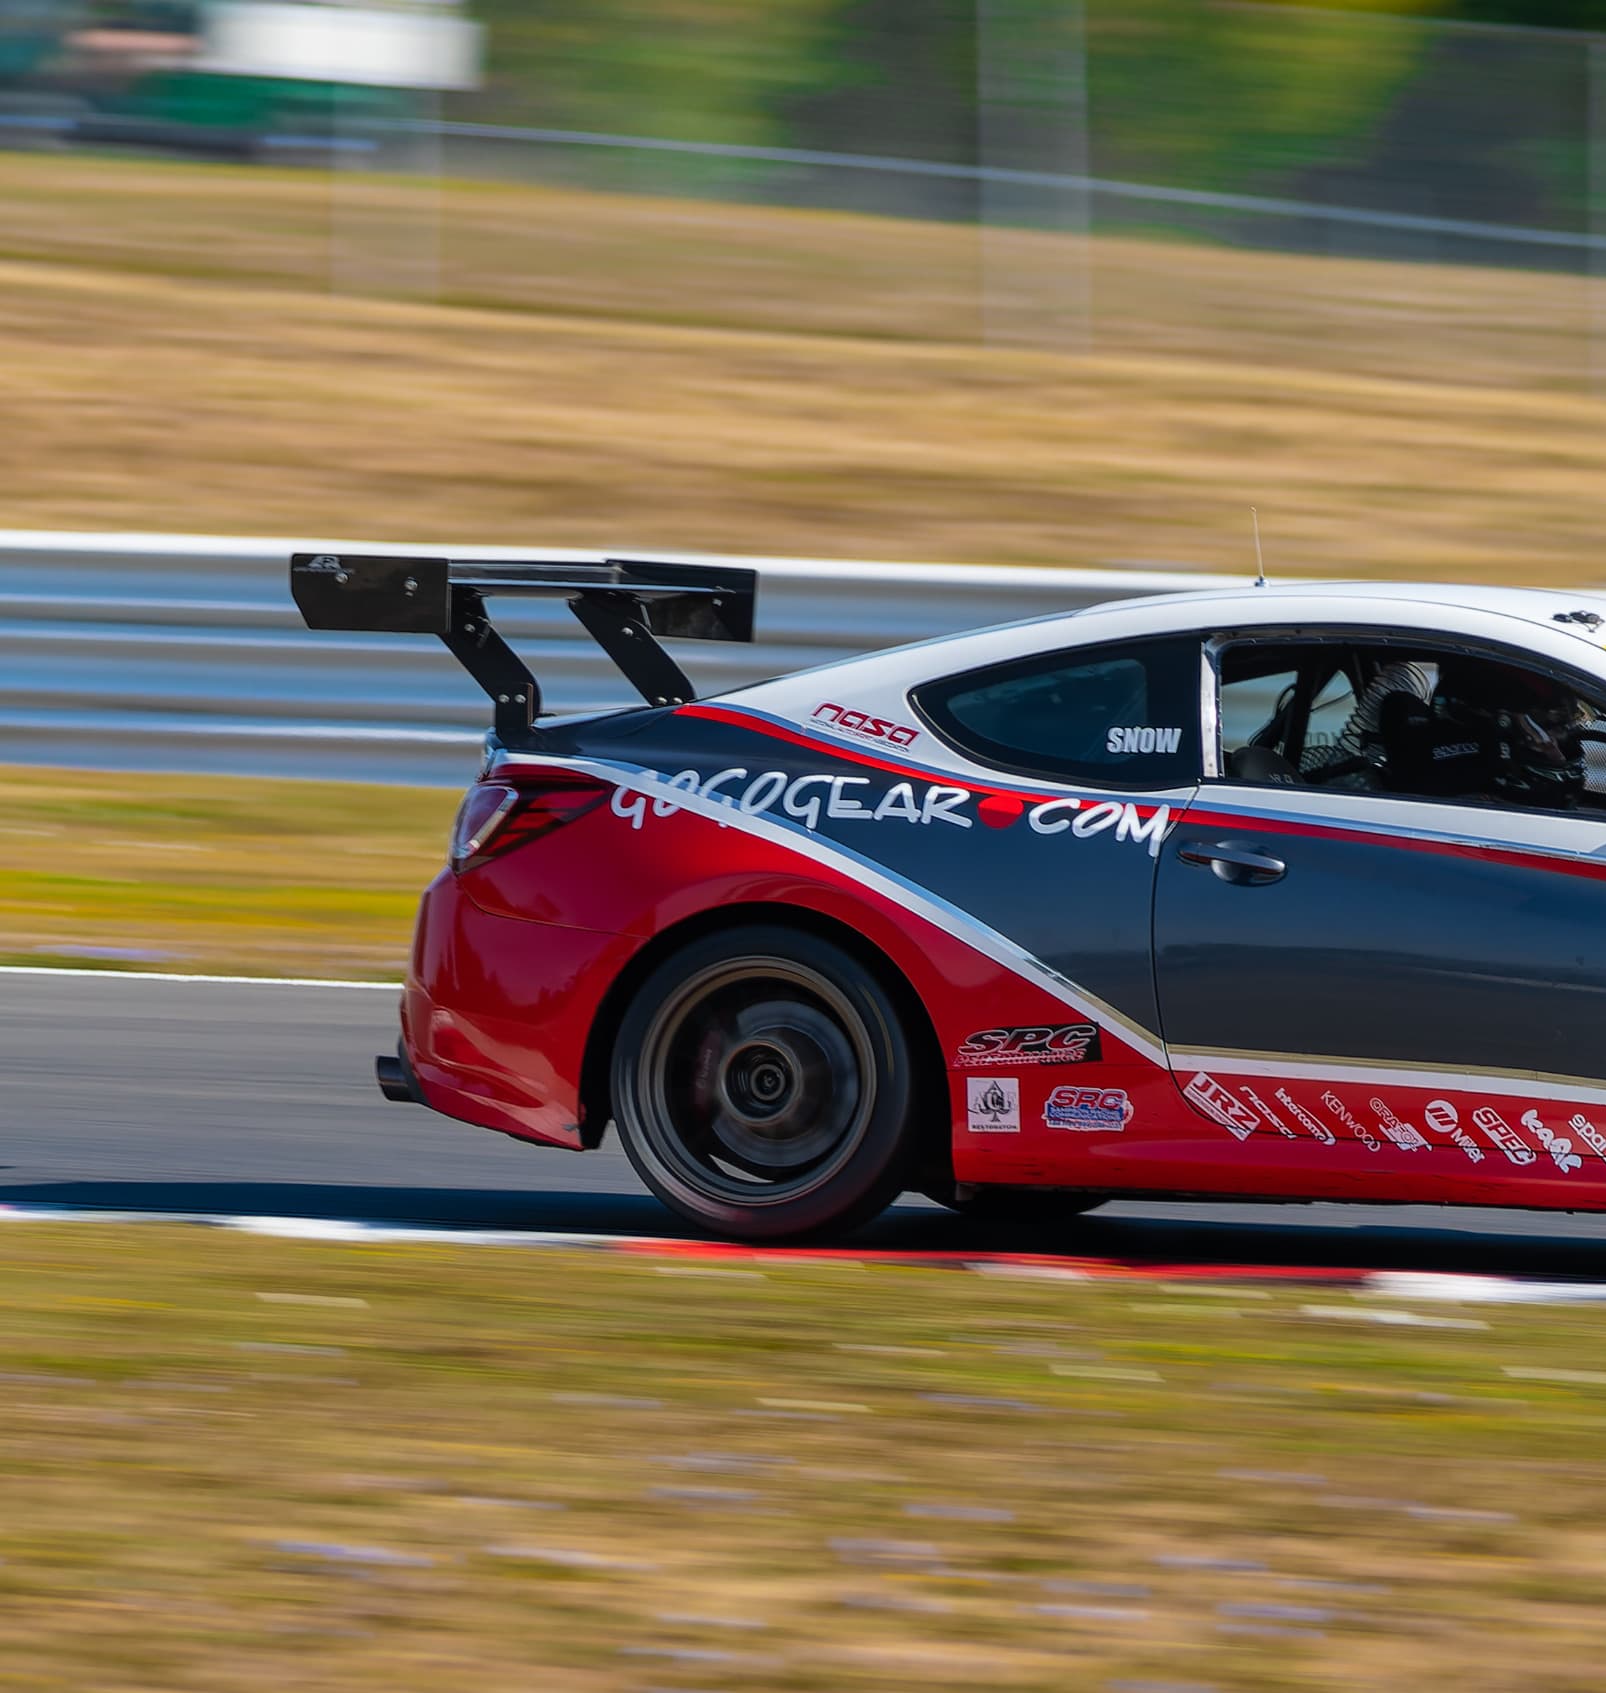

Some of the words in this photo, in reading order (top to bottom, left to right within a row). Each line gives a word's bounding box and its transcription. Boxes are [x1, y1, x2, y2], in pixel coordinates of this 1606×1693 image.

[812, 702, 920, 746] nasa
[1106, 726, 1182, 754] SNOW
[957, 1024, 1097, 1055] SPC
[1051, 1087, 1124, 1110] SRC
[1193, 1078, 1258, 1131] JRZ
[1320, 1089, 1381, 1152] KENWOOD
[1474, 1108, 1535, 1164] SPEC
